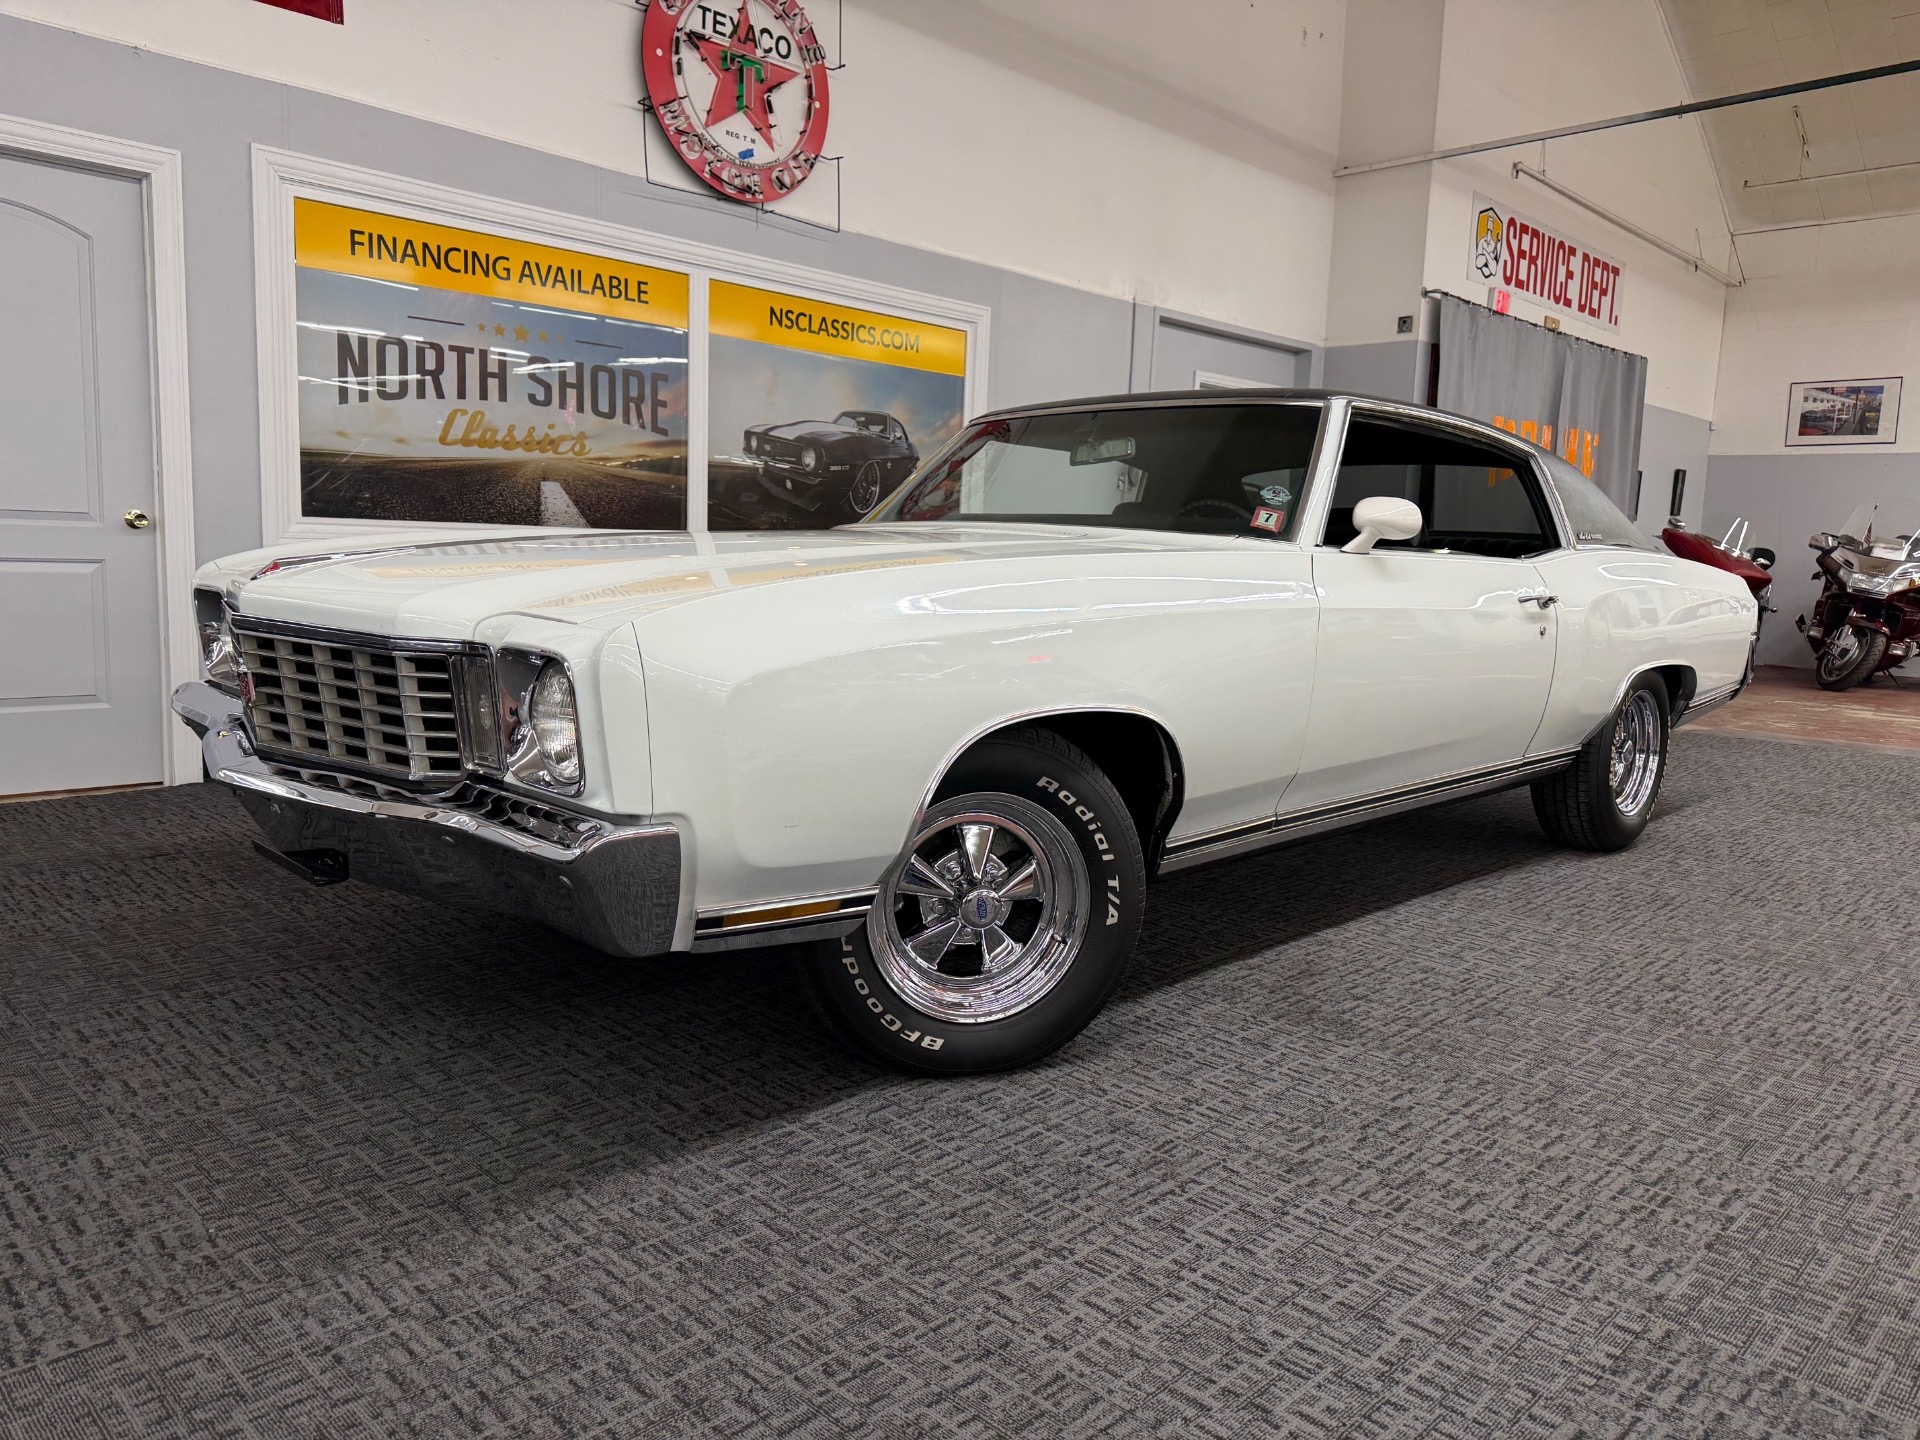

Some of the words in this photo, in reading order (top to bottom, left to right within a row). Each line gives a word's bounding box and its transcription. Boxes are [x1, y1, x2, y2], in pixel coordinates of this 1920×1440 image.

[698, 5, 792, 60] TEXACO
[349, 229, 511, 282] FINANCING
[517, 260, 649, 305] AVAILABLE
[1502, 216, 1577, 309] SERVICE
[1577, 251, 1620, 326] DEPT.
[769, 305, 920, 353] NSCLASSICS.COM
[336, 329, 508, 405] NORTH
[527, 354, 669, 437] SHORE
[438, 407, 592, 457] Classics
[1264, 512, 1274, 523] 7
[1036, 776, 1115, 861] Radial
[1105, 875, 1120, 926] T/A
